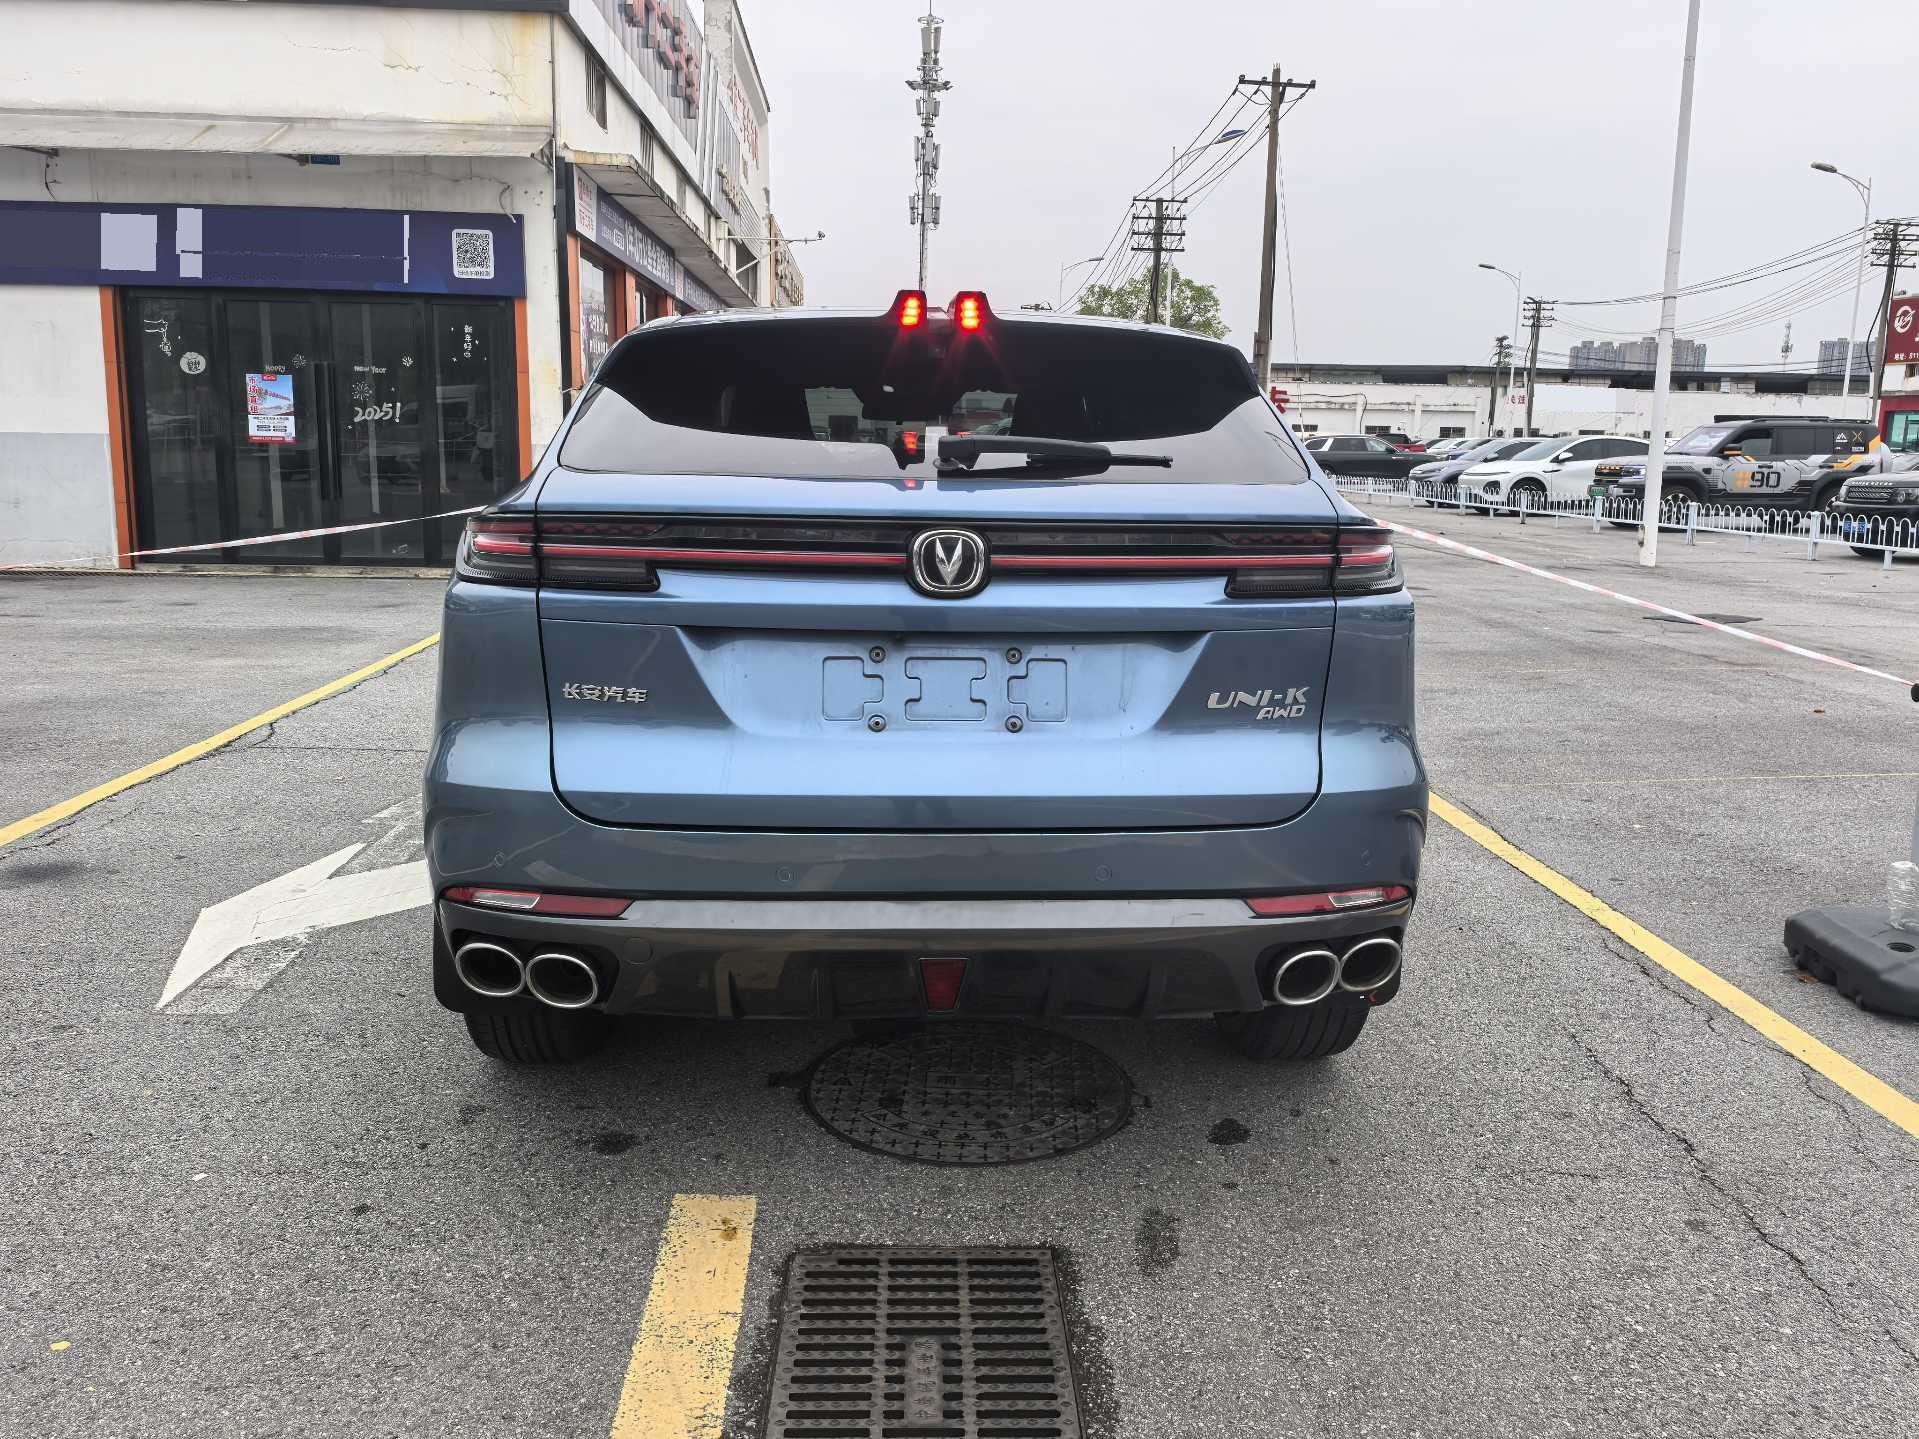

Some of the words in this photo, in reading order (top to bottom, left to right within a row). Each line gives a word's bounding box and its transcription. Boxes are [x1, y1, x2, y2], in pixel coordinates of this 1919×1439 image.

[353, 401, 401, 423] 2025!
[1735, 470, 1781, 489] #90
[562, 682, 648, 703] 长安汽车
[1207, 686, 1311, 709] UNI-K
[1255, 704, 1306, 720] AWD
